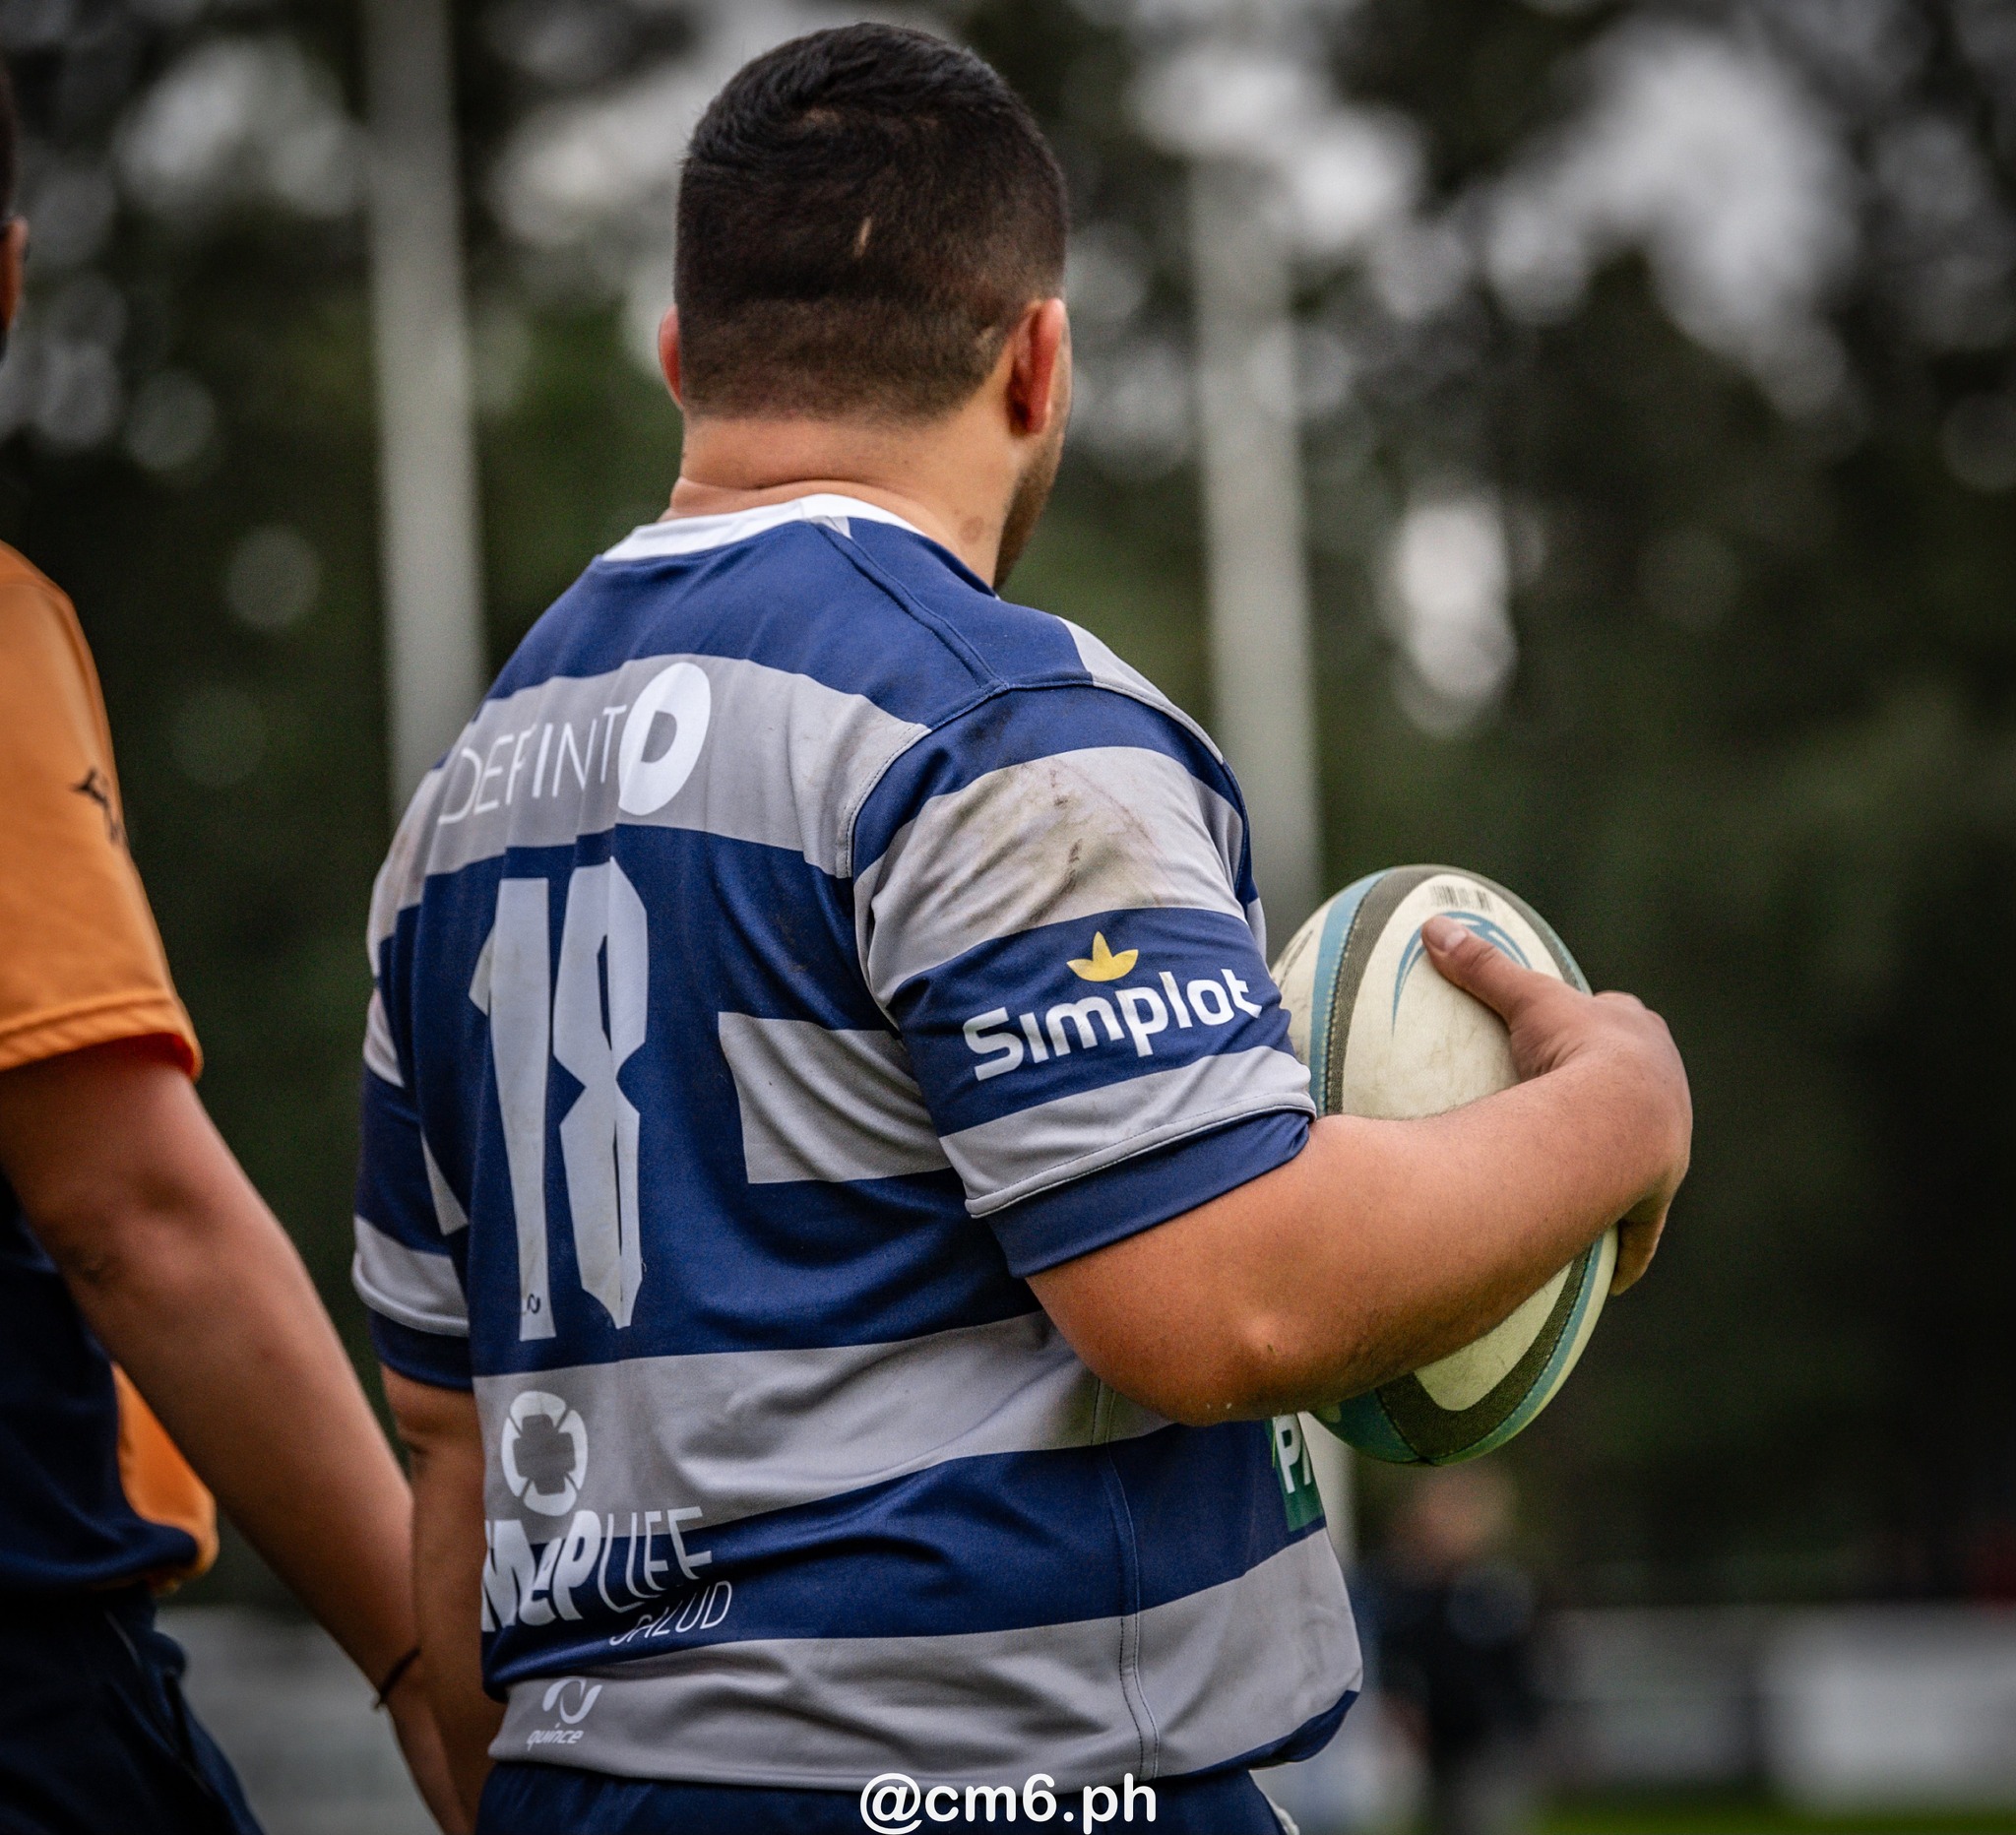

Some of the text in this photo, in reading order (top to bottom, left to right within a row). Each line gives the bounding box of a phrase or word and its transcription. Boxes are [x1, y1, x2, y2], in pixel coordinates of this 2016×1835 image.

[963, 968, 1263, 1082] Simplot
[469, 855, 650, 1342] 18
[608, 1580, 732, 1646] SALUD
[526, 1722, 585, 1751] quince
